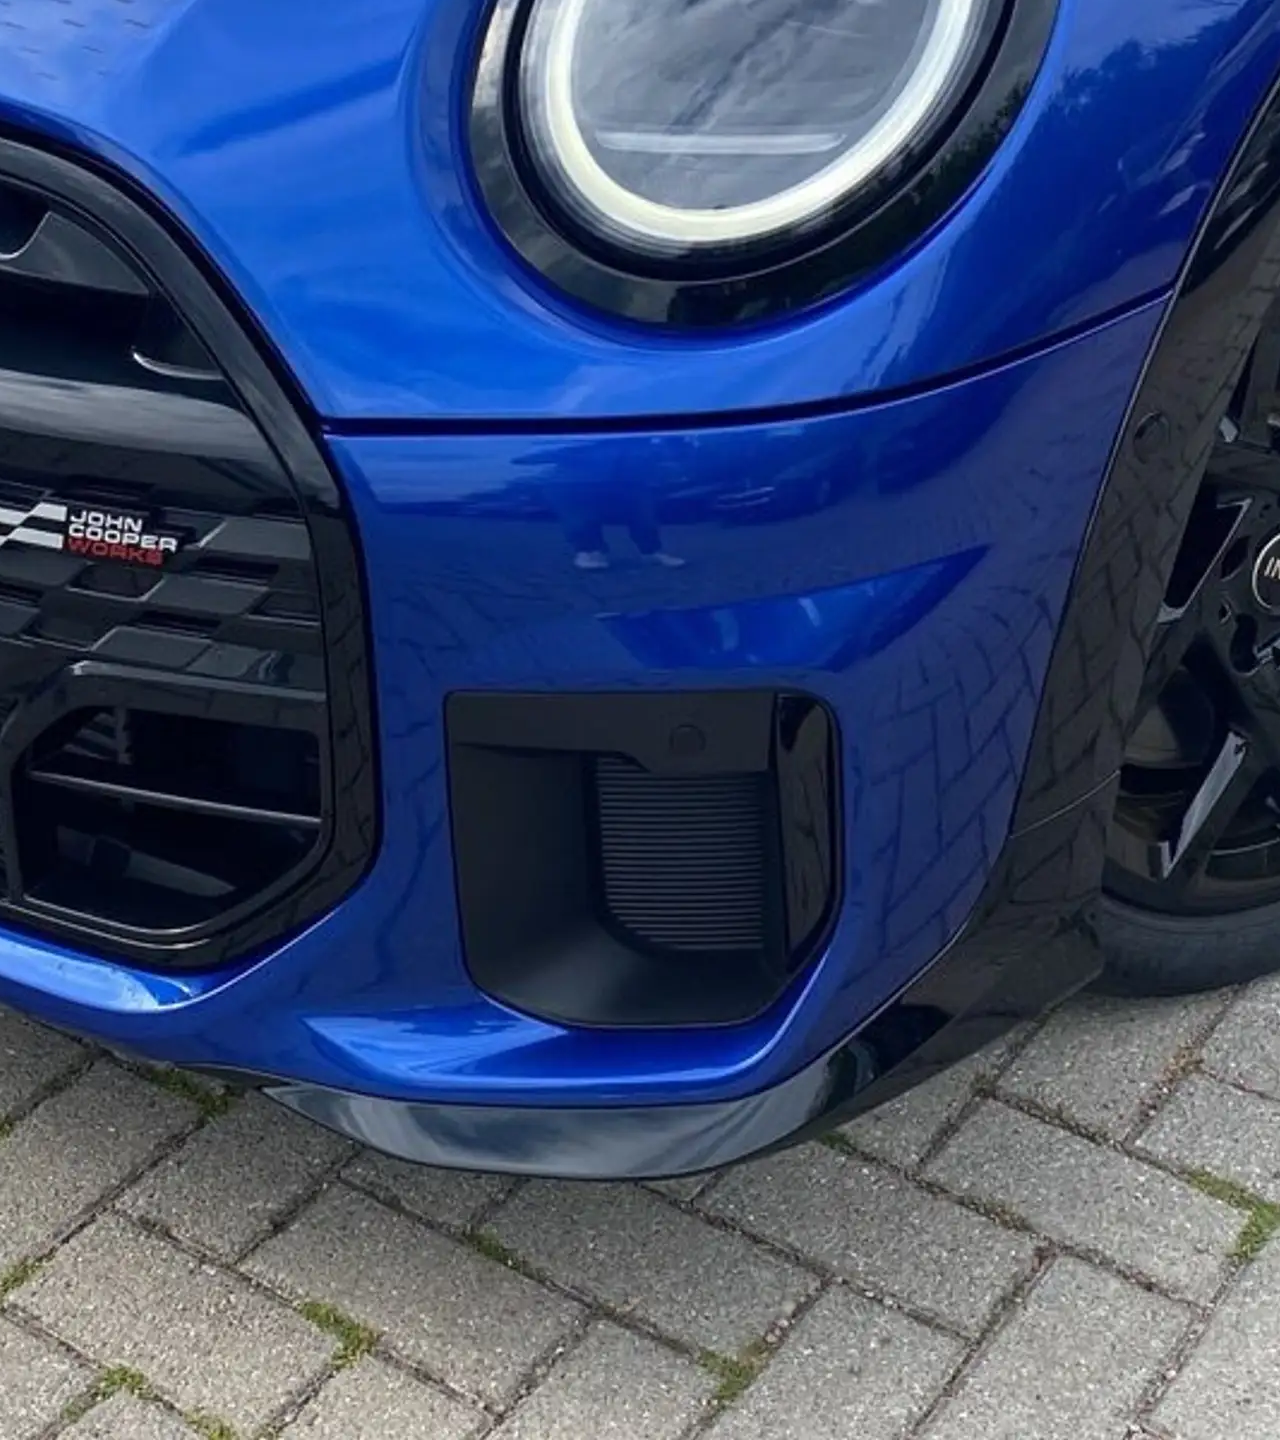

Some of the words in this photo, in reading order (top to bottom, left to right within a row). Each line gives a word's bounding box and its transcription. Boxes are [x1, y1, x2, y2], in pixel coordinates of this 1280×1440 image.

[69, 509, 143, 533] JOHN
[67, 538, 163, 566] WORKS
[68, 523, 179, 553] COOPER
